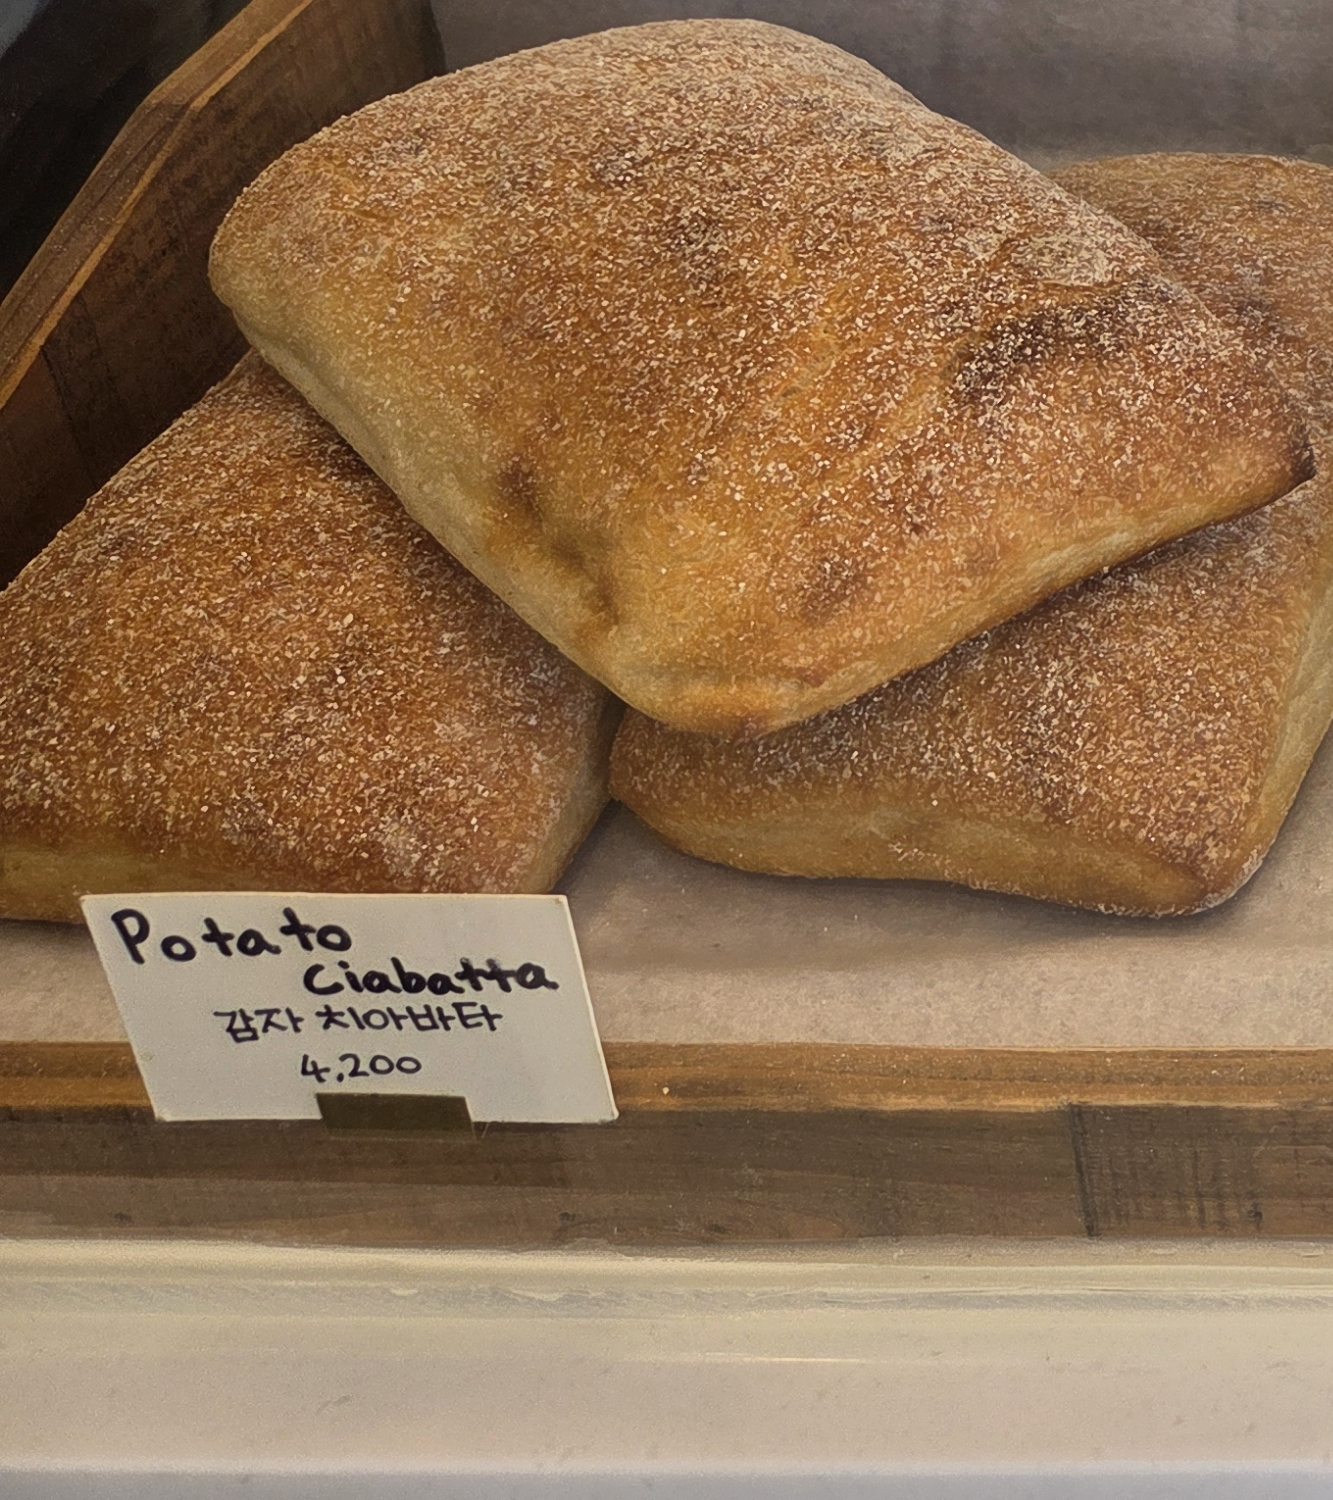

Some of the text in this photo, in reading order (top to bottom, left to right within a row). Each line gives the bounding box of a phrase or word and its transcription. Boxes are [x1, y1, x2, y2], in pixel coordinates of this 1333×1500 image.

[110, 907, 352, 965] Potato
[302, 956, 560, 996] Ciabatta
[213, 1000, 503, 1043] 감자 치아바타
[300, 1053, 423, 1083] 4,200
